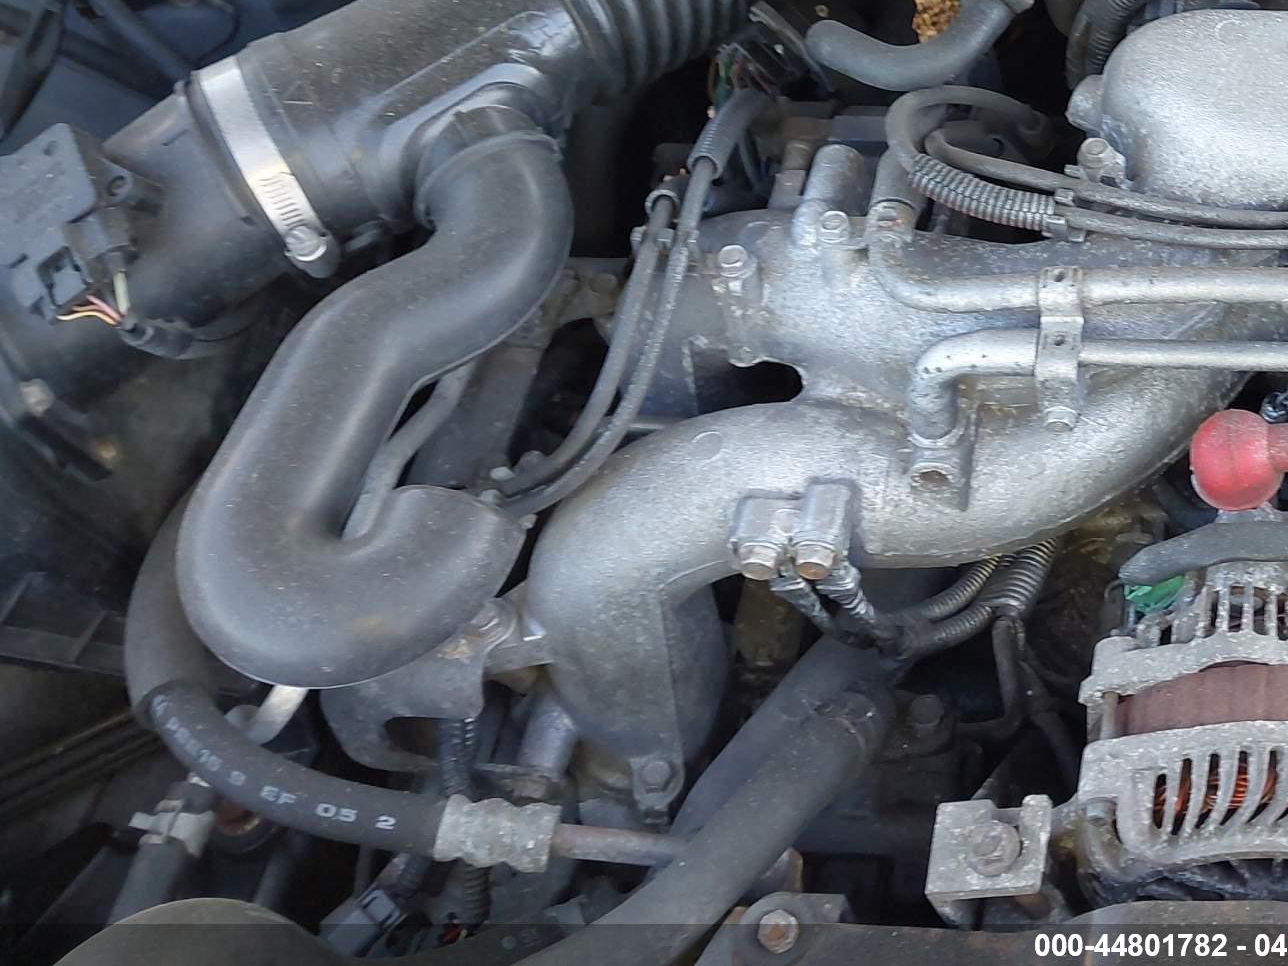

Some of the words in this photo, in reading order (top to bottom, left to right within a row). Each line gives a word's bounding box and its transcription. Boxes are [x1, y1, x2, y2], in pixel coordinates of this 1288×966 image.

[260, 785, 297, 804] EF
[315, 802, 358, 822] 05
[375, 815, 396, 830] 2
